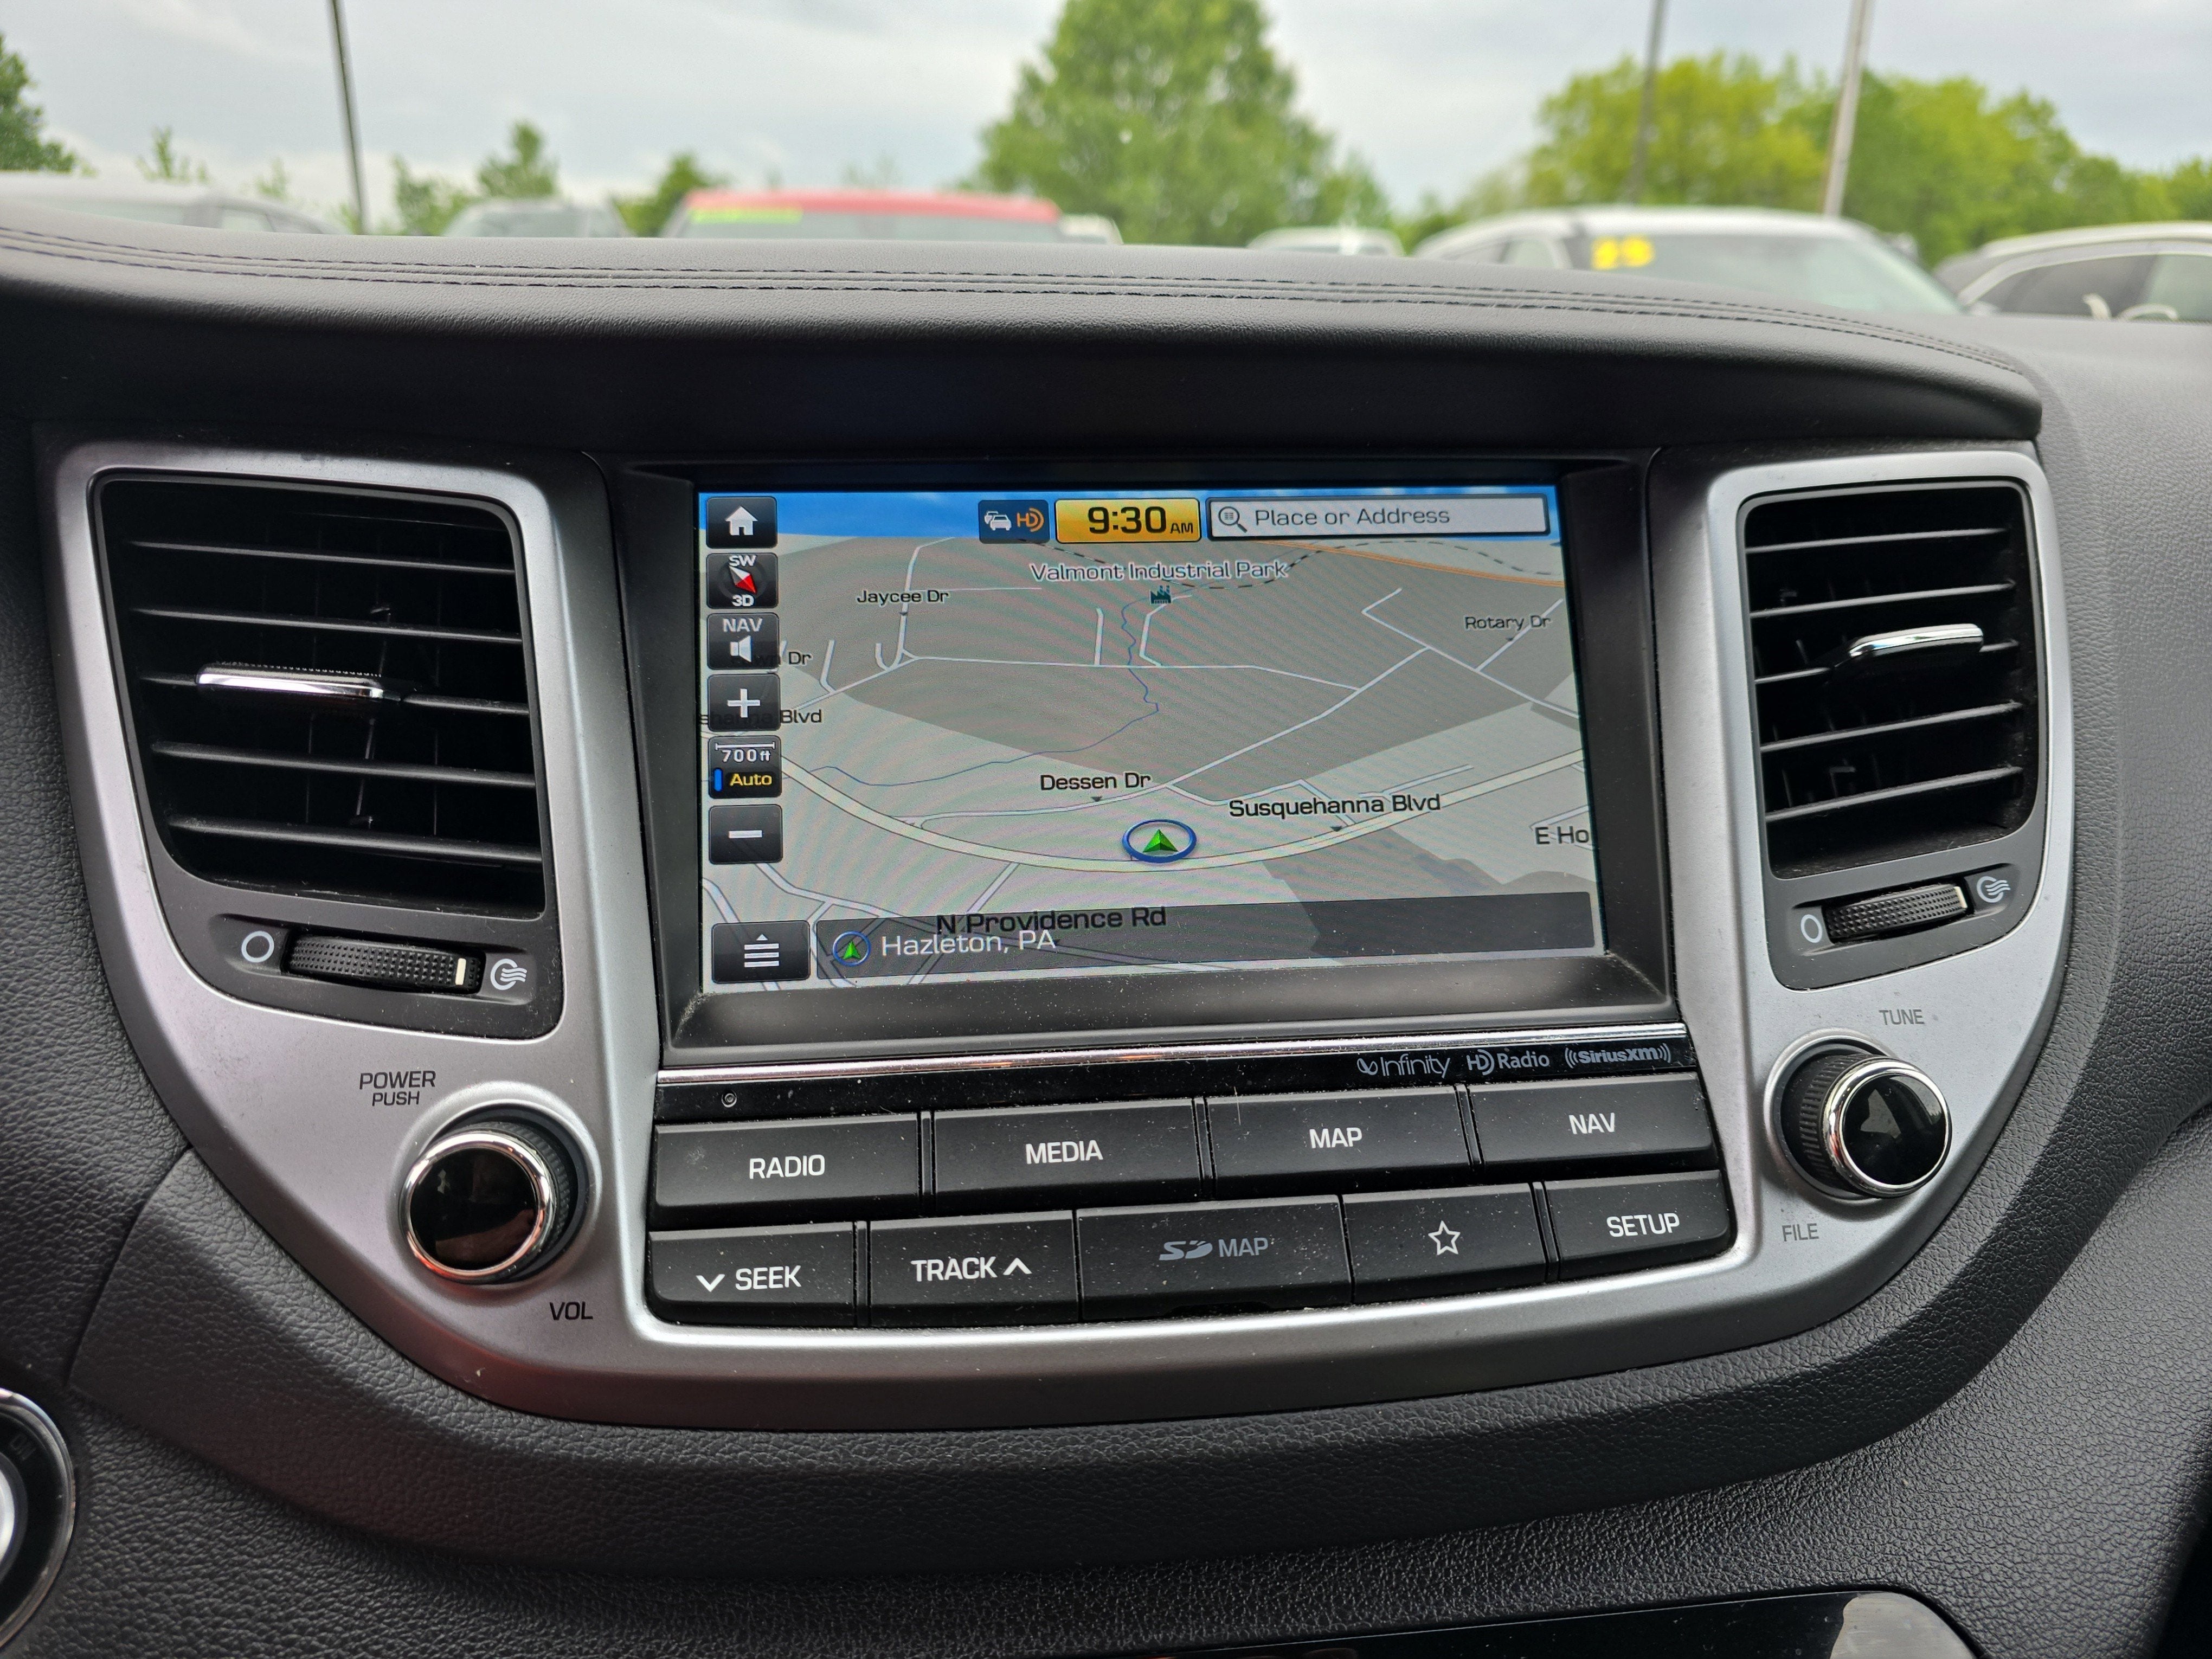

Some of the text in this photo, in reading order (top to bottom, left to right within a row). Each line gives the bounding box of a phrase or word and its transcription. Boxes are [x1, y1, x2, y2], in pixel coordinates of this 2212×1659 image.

[1088, 506, 1194, 534] 9:30 AM
[1255, 507, 1450, 526] Place or Address
[729, 555, 756, 567] SW
[1031, 559, 1289, 581] Valmont Industrial Park
[732, 594, 754, 607] 3D
[857, 589, 949, 604] Jaycee Dr
[722, 618, 762, 633] NAV
[1465, 615, 1551, 631] Rotary Dr
[788, 651, 812, 665] Dr
[780, 709, 822, 724] Blvd
[722, 749, 770, 763] 700 ft
[730, 773, 773, 786] Auto
[1040, 772, 1151, 791] Dessen Dr
[1229, 794, 1441, 819] Susquehanna Blvd
[1535, 826, 1590, 844] E Ho
[936, 906, 1167, 934] N Providence Rd
[882, 930, 1056, 956] Hazleton, PA
[1879, 1009, 1925, 1026] TUNE
[1380, 1054, 1451, 1079] Infinity
[1499, 1052, 1551, 1069] Radio
[359, 1070, 436, 1090] POWER
[372, 1091, 420, 1107] PUSH
[1568, 1113, 1616, 1135] NAV
[1309, 1127, 1362, 1149] MAP
[1025, 1140, 1103, 1165] MEDIA
[749, 1155, 825, 1180] RADIO
[1606, 1212, 1680, 1238] SETUP
[1782, 1223, 1819, 1242] FILE
[1219, 1237, 1269, 1258] MAP
[735, 1265, 801, 1290] SEEK
[911, 1257, 997, 1282] TRACK
[549, 1301, 593, 1321] VOL
